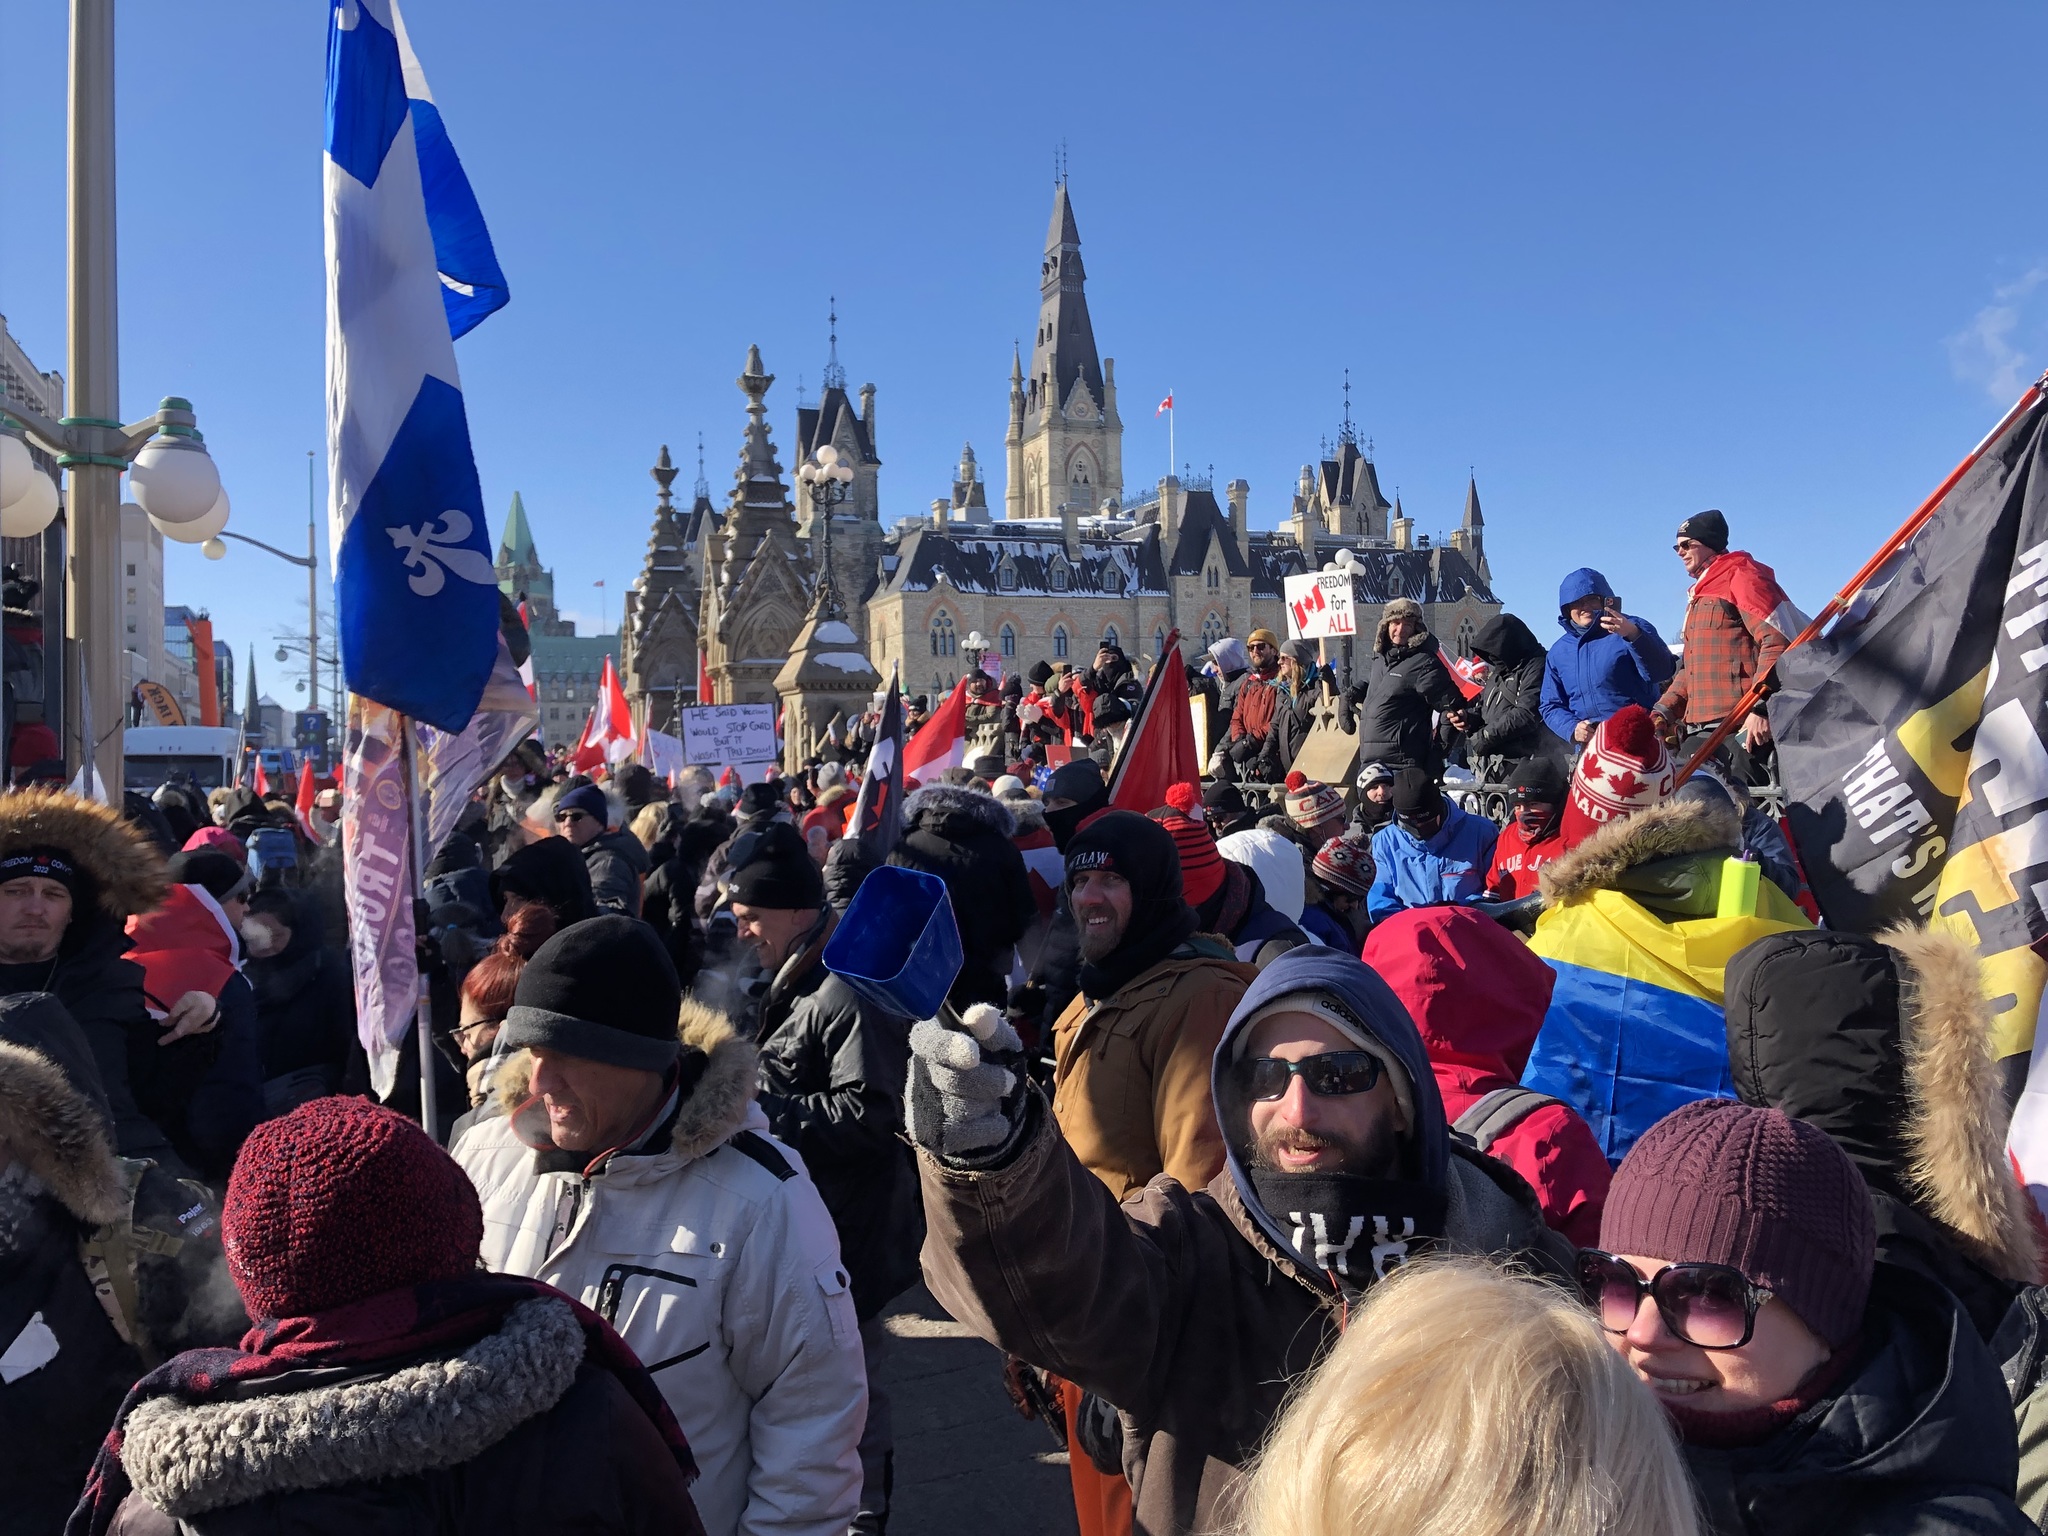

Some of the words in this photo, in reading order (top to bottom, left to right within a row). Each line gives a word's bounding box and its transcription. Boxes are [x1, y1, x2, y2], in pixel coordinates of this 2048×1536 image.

[1317, 574, 1351, 590] FREEDOM
[1331, 594, 1347, 611] for
[1328, 613, 1354, 634] ALL
[691, 708, 709, 721] HE
[726, 721, 748, 734] STOP
[1842, 737, 1946, 879] THAT'S
[33, 865, 49, 874] 2022
[178, 1202, 203, 1224] Pajar
